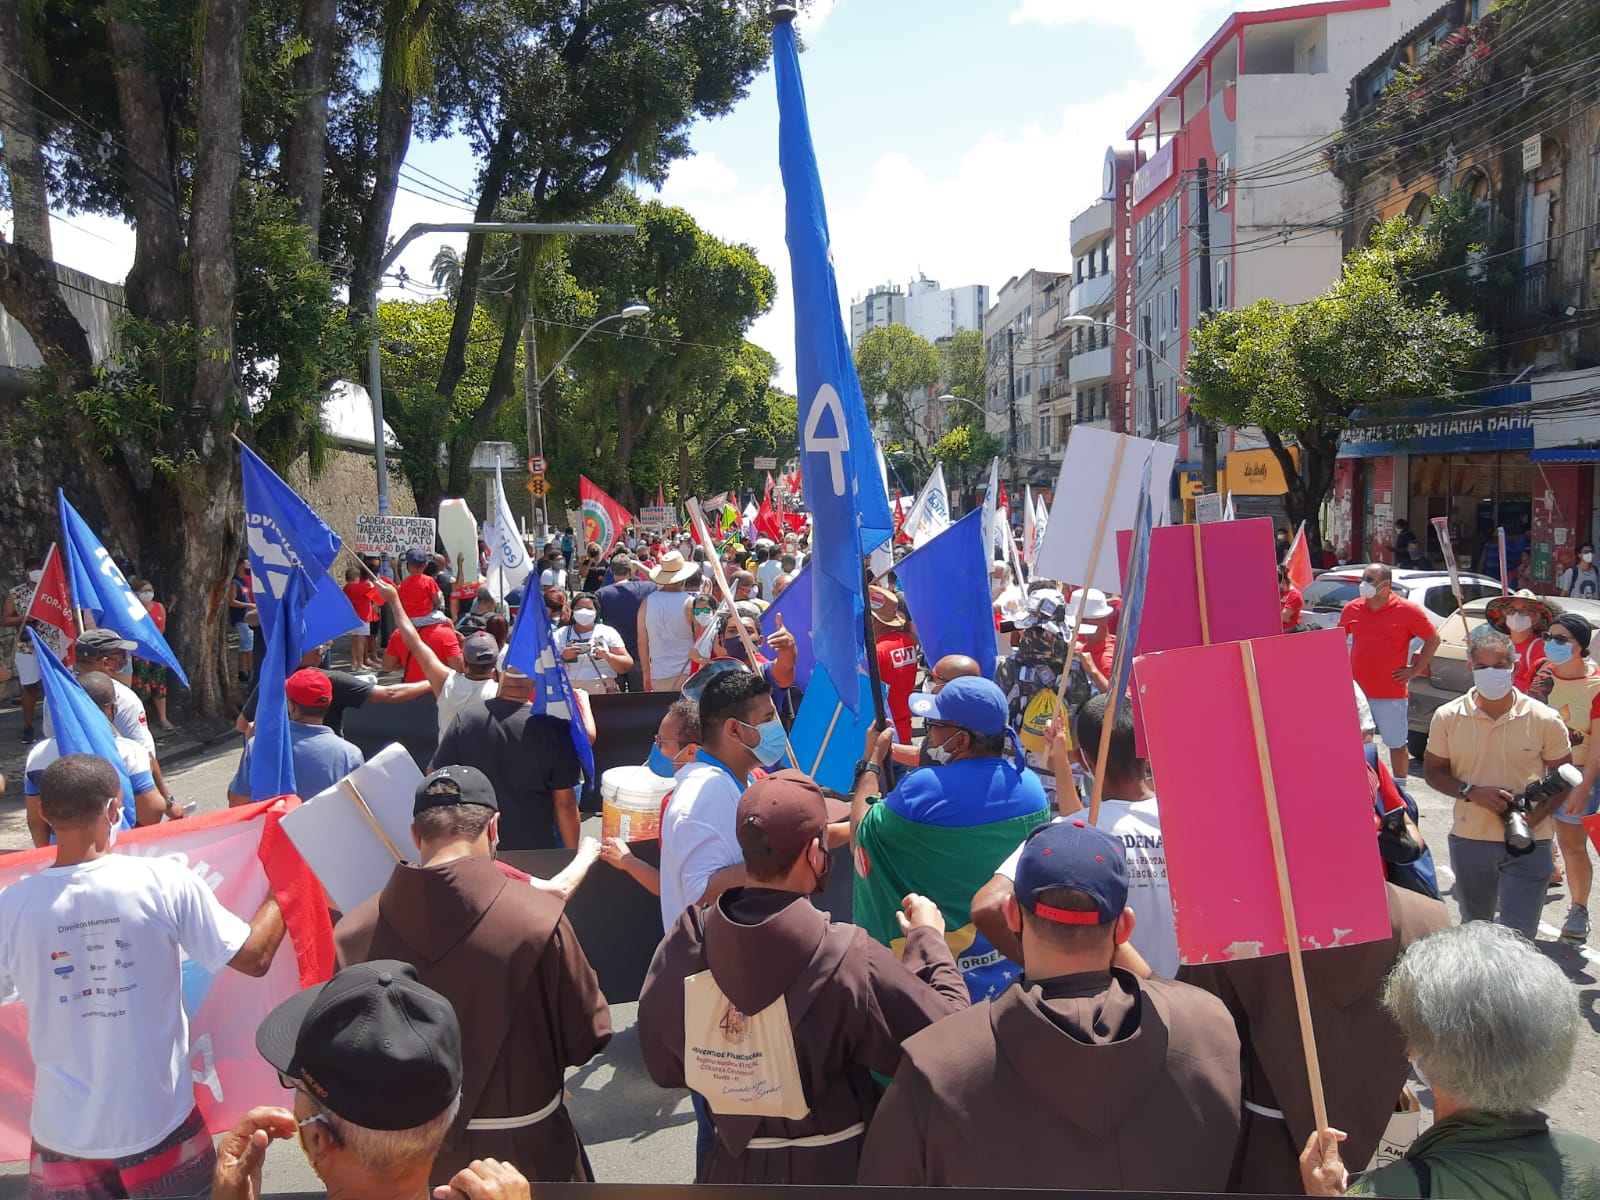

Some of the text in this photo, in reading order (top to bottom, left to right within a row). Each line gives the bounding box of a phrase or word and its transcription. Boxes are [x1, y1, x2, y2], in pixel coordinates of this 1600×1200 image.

[359, 515, 386, 525] CADEIA
[392, 518, 433, 528] GOLPISTAS
[394, 527, 405, 535] DA
[395, 544, 406, 553] DA
[893, 646, 914, 663] CUT
[58, 916, 120, 934] Direitos Humanos
